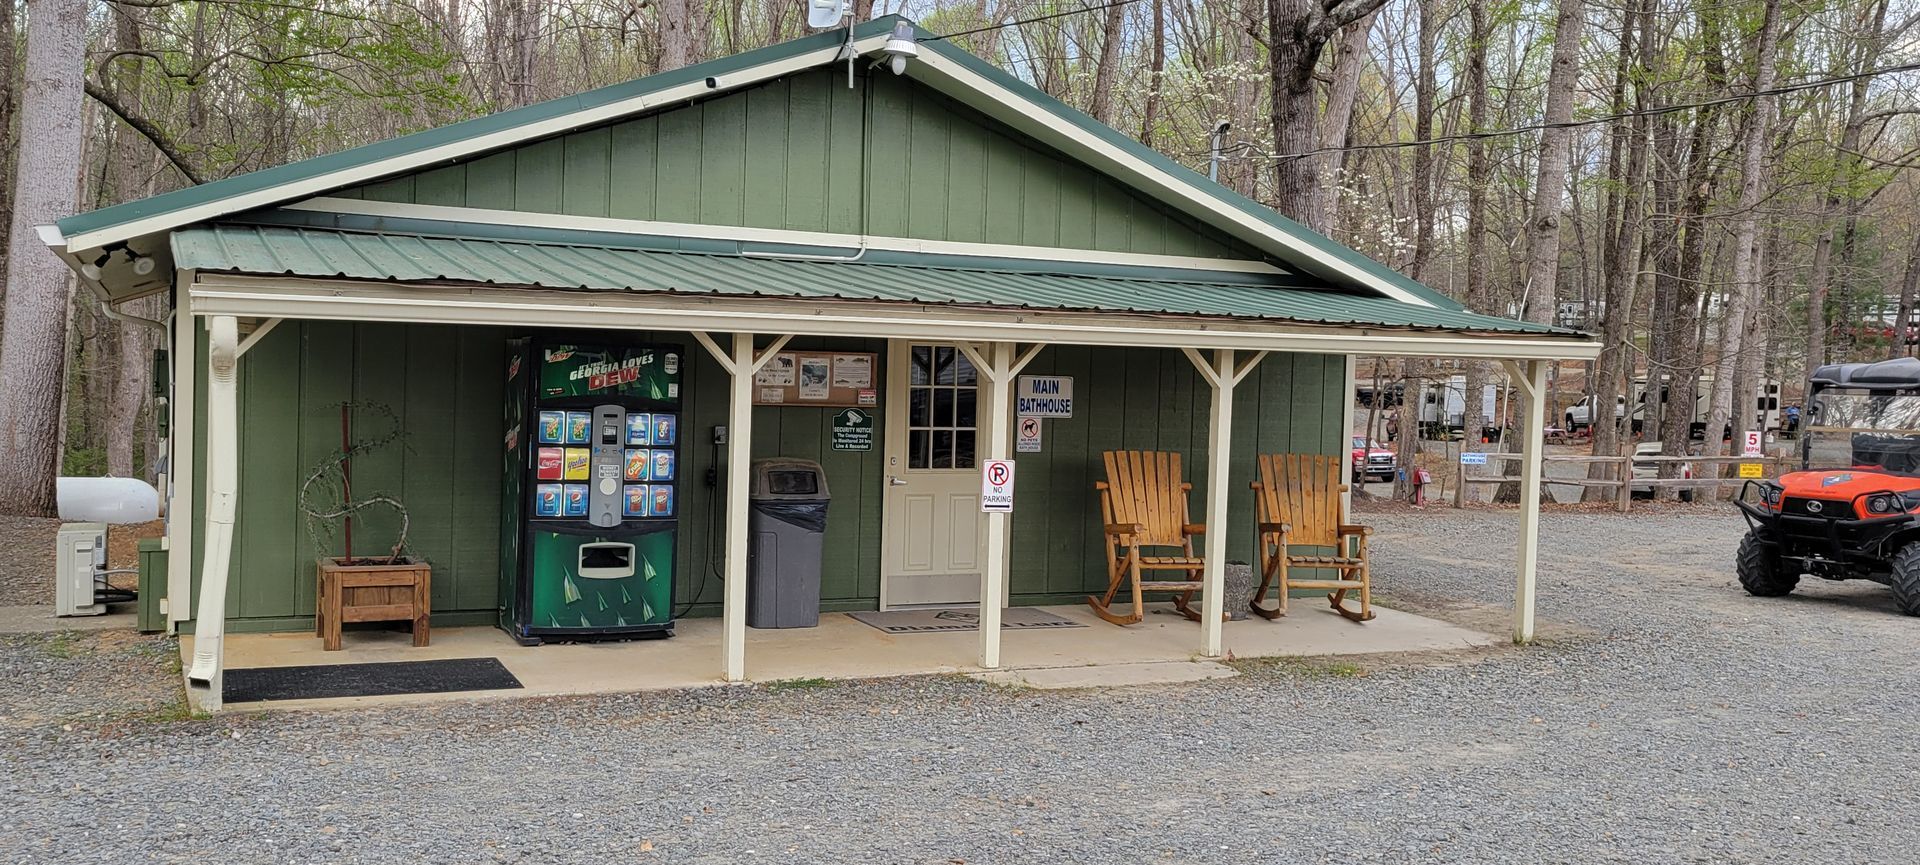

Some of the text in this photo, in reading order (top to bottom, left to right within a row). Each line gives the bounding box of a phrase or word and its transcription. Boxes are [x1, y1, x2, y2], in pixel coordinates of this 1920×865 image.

[569, 361, 619, 381] GEORGIA
[621, 353, 654, 369] LOVES
[588, 366, 641, 391] DEW
[1032, 380, 1059, 394] MAIN
[1020, 398, 1070, 412] BATHHOUSE
[1749, 434, 1757, 445] 5
[993, 486, 1003, 494] NO
[983, 495, 1012, 503] PARKING
